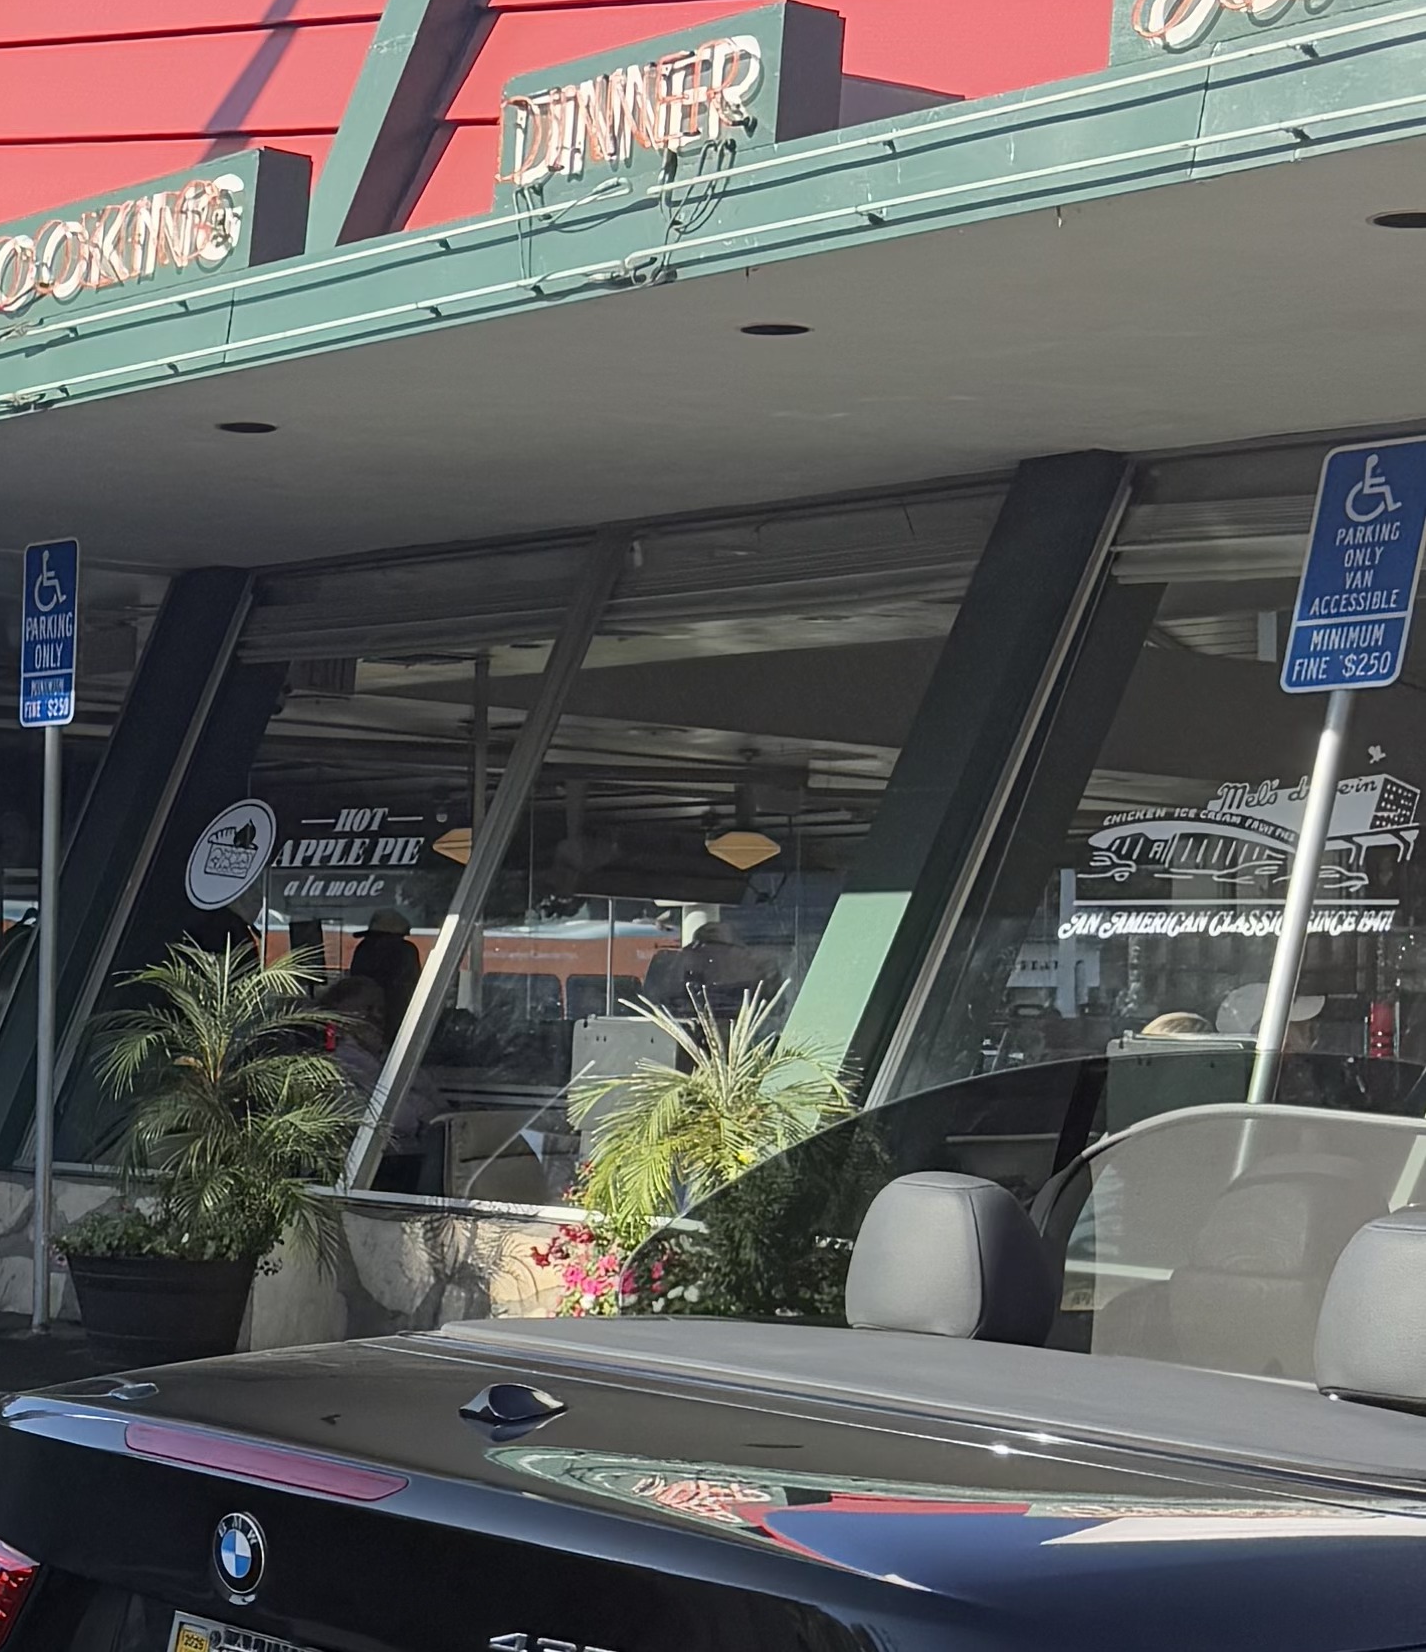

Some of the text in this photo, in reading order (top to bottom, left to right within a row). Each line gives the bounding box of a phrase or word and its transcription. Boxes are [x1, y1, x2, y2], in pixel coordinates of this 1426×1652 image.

[495, 35, 761, 186] DINNER
[1336, 522, 1401, 547] PARKING
[1344, 547, 1384, 568] ONLY
[1345, 569, 1374, 590] VAN
[1309, 589, 1400, 616] ACCESSIBLE
[26, 613, 73, 642] PARKING
[1310, 623, 1386, 652] MINIMUM
[34, 644, 64, 670] ONLY
[1292, 651, 1392, 682] FINE $250
[333, 807, 389, 833] HOT
[1103, 808, 1166, 827] CHICKEN
[1174, 808, 1198, 819] ICE
[1199, 809, 1242, 825] CREAM
[271, 836, 425, 868] APPLE PIE
[283, 874, 385, 897] a la mode
[1058, 911, 1101, 940] AN
[1098, 910, 1209, 940] AMERICAN
